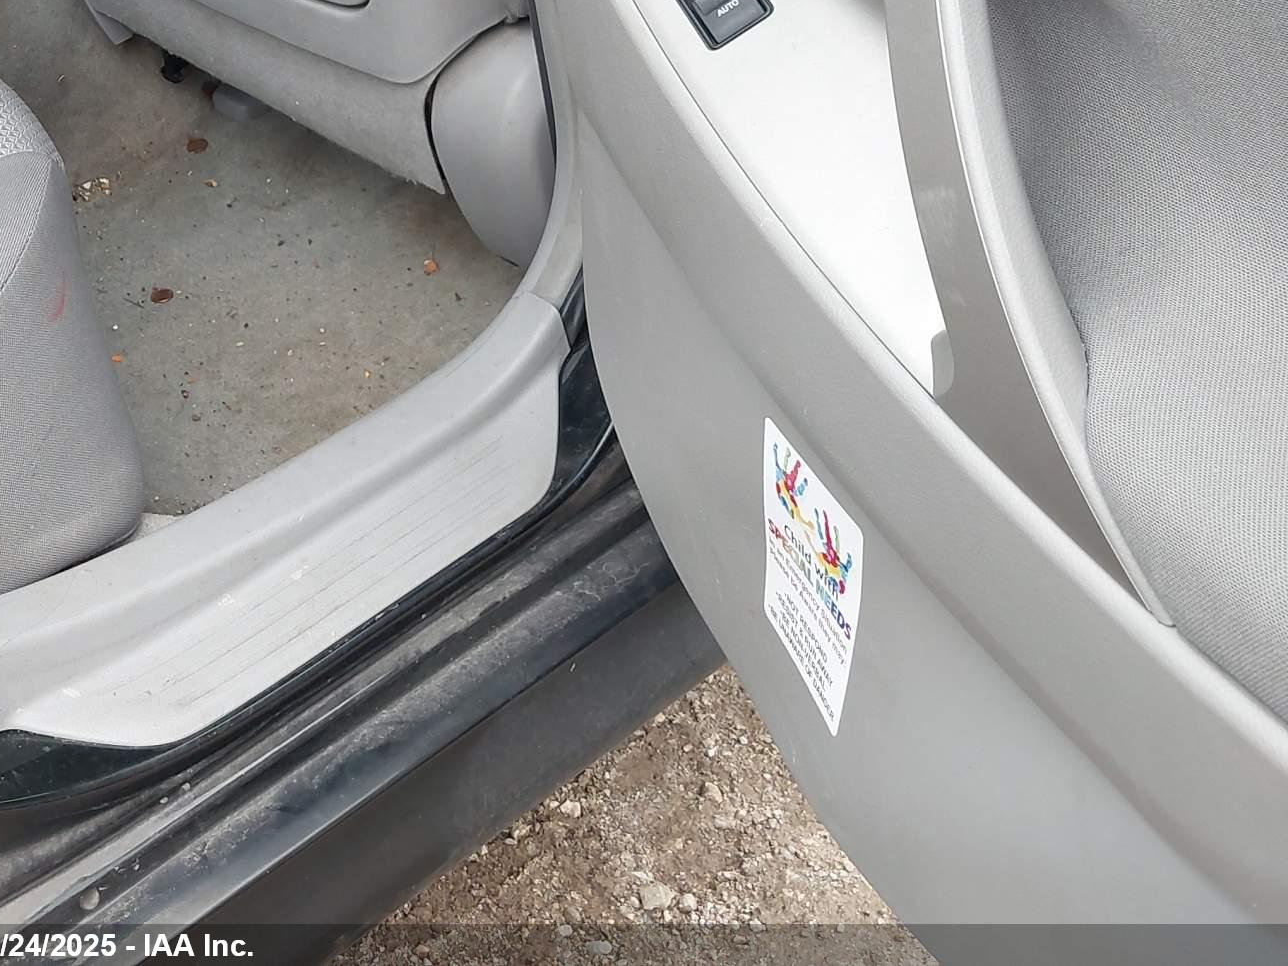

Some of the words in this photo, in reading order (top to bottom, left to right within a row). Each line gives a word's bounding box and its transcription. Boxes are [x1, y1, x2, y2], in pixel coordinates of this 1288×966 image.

[717, 0, 739, 17] AUTO
[768, 518, 814, 587] SPECIAL
[816, 578, 852, 640] NEEDS
[784, 524, 812, 566] Child
[814, 563, 839, 601] with
